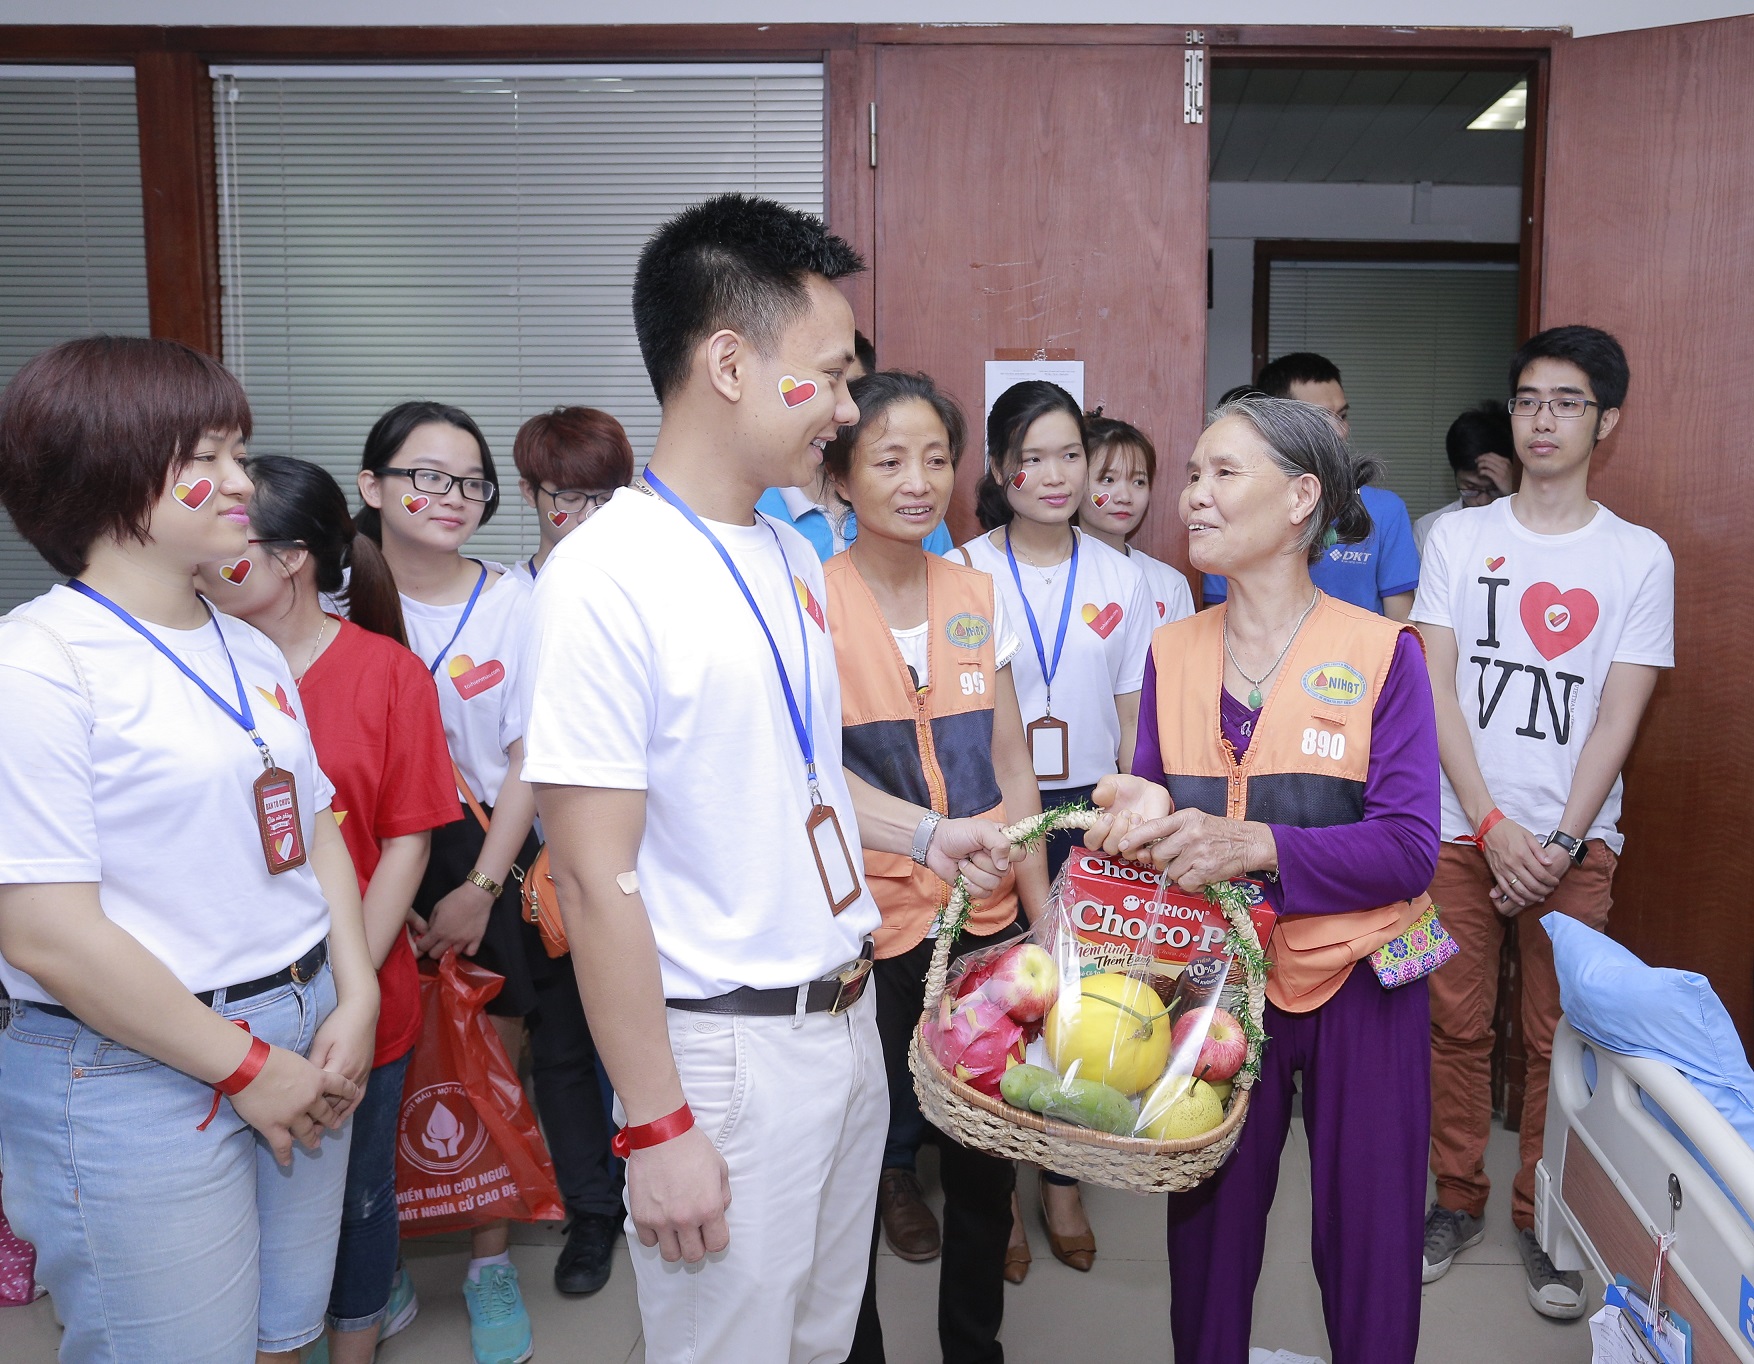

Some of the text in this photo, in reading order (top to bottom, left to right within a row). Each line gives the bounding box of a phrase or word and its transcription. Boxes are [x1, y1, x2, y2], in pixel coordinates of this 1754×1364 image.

[1342, 551, 1372, 561] DKT
[1476, 576, 1510, 648] I
[1328, 676, 1360, 695] NIHBT
[1470, 655, 1585, 745] VN
[1301, 727, 1346, 761] 890
[1144, 900, 1206, 922] ORION
[1185, 963, 1214, 977] 10%
[414, 1090, 433, 1105] MÁU
[425, 1183, 452, 1199] MÁU
[479, 1163, 510, 1185] NGƯỜ
[420, 1201, 457, 1218] NGHĨA
[476, 1188, 500, 1207] CAO
[501, 1182, 518, 1198] ĐẸ
